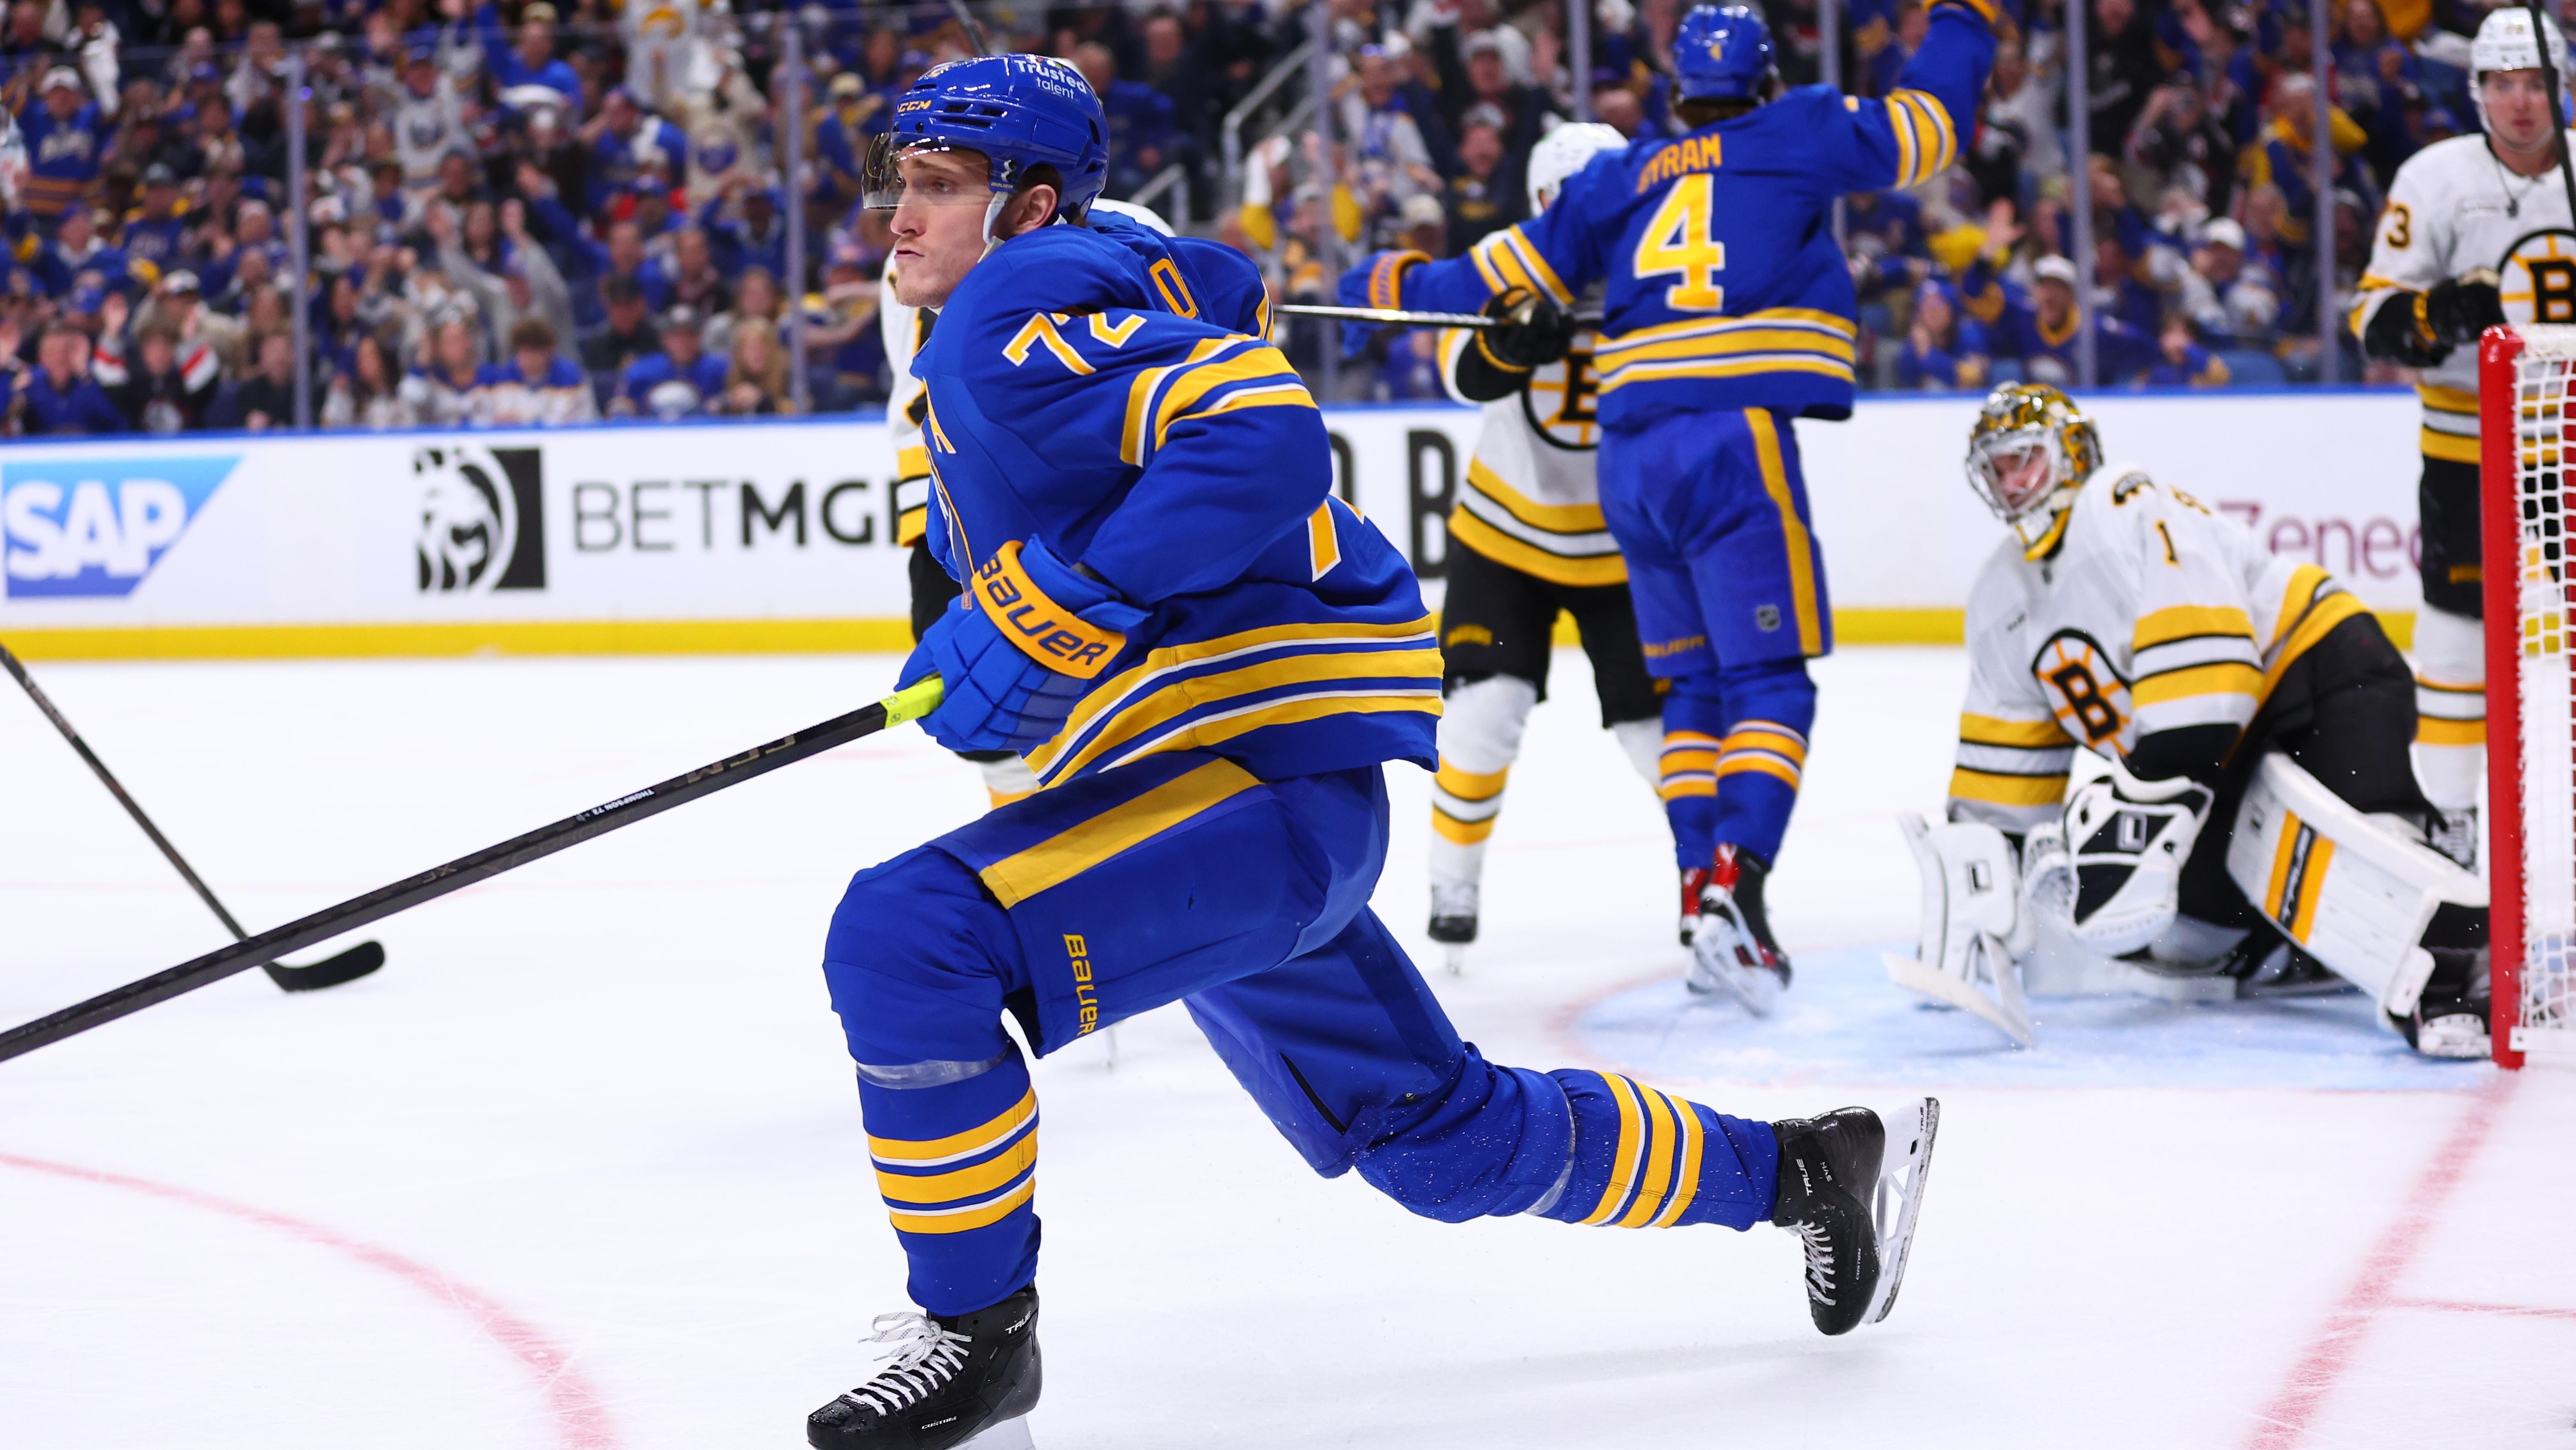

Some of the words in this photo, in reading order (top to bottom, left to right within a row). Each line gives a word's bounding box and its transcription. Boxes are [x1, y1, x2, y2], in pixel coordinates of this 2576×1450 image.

[1013, 59, 1087, 95] Trusted
[1036, 77, 1075, 99] talent
[898, 100, 932, 113] CCM
[1633, 172, 1726, 312] 4
[2387, 202, 2412, 249] 3
[5, 480, 188, 580] SAP
[2052, 661, 2119, 742] B
[604, 789, 655, 811] THOMPSON
[1796, 1158, 1813, 1196] TRUE
[1005, 1310, 1032, 1335] TRUE
[921, 1415, 957, 1430] CUSTOM
